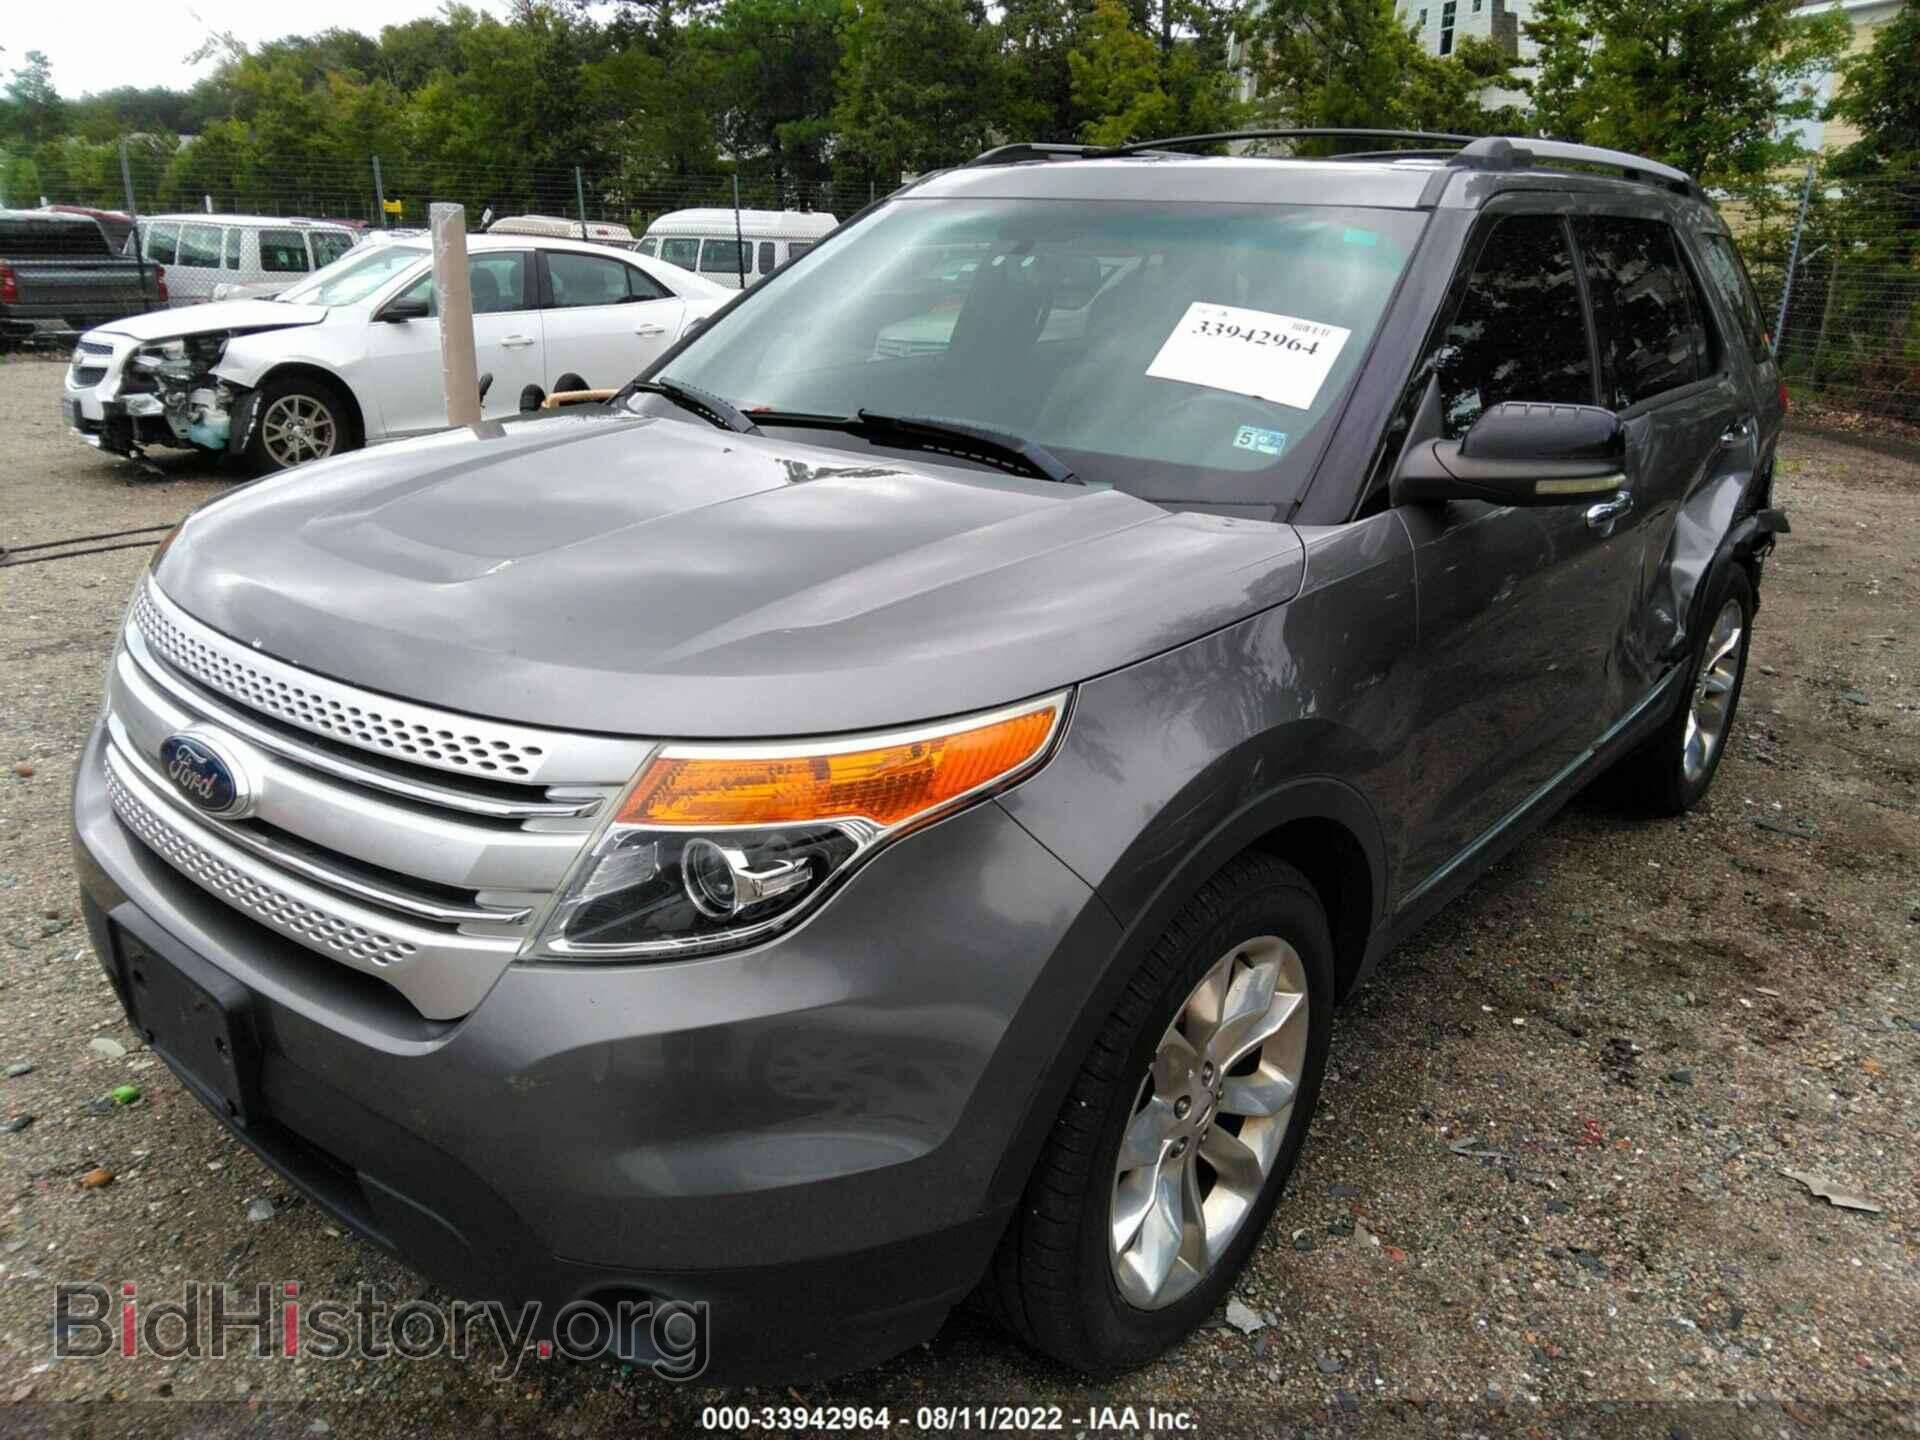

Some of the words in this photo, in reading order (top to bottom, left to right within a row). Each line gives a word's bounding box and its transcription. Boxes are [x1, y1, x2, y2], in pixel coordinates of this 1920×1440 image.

[1193, 320, 1319, 355] 33942964
[1238, 431, 1253, 446] 5
[169, 744, 218, 799] Ford
